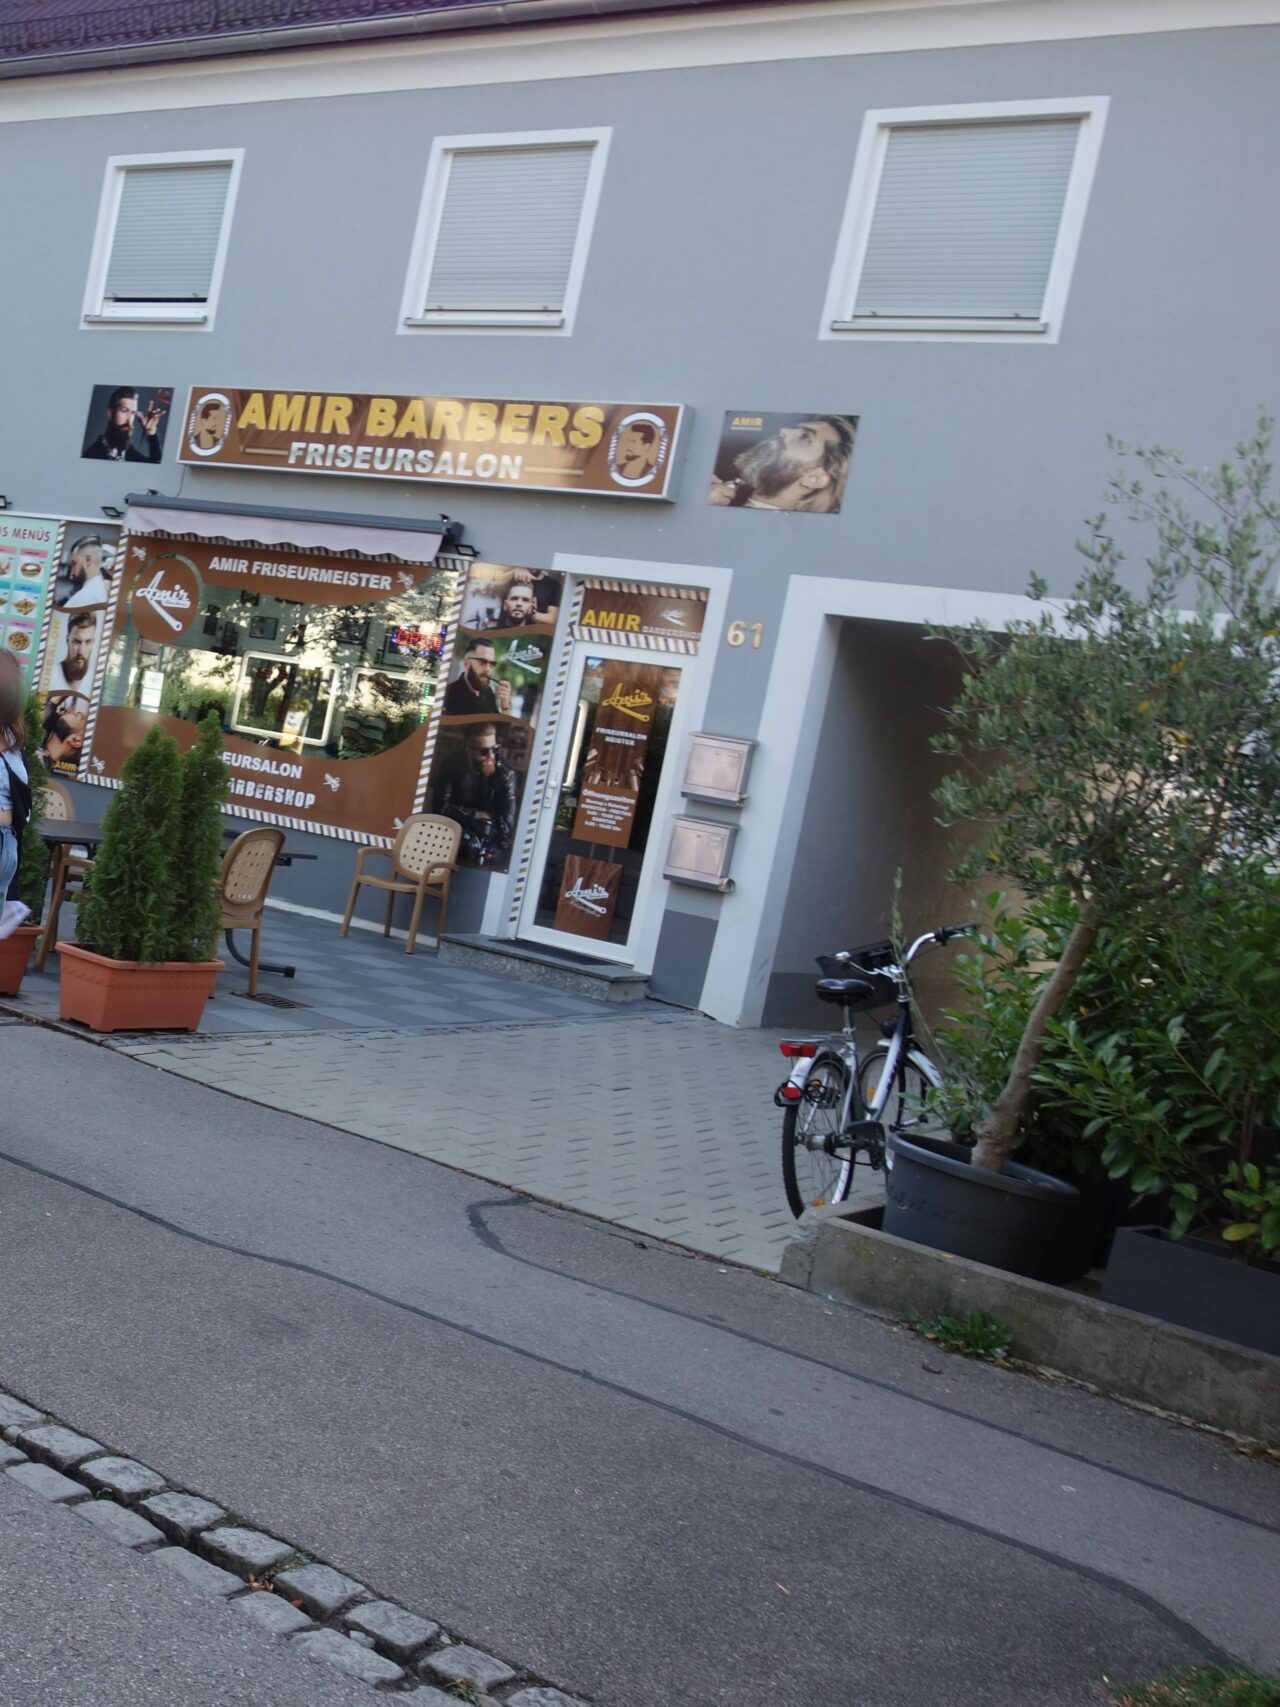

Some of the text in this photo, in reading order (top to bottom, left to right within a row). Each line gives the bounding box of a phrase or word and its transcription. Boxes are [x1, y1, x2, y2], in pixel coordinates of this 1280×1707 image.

[237, 391, 605, 449] AMIR BARBERS
[731, 416, 764, 427] AMIR
[287, 441, 524, 480] FRISEURSALON
[208, 556, 392, 591] AMIR FRISEURMEISTER
[580, 609, 642, 632] AMIR
[726, 620, 763, 648] 61
